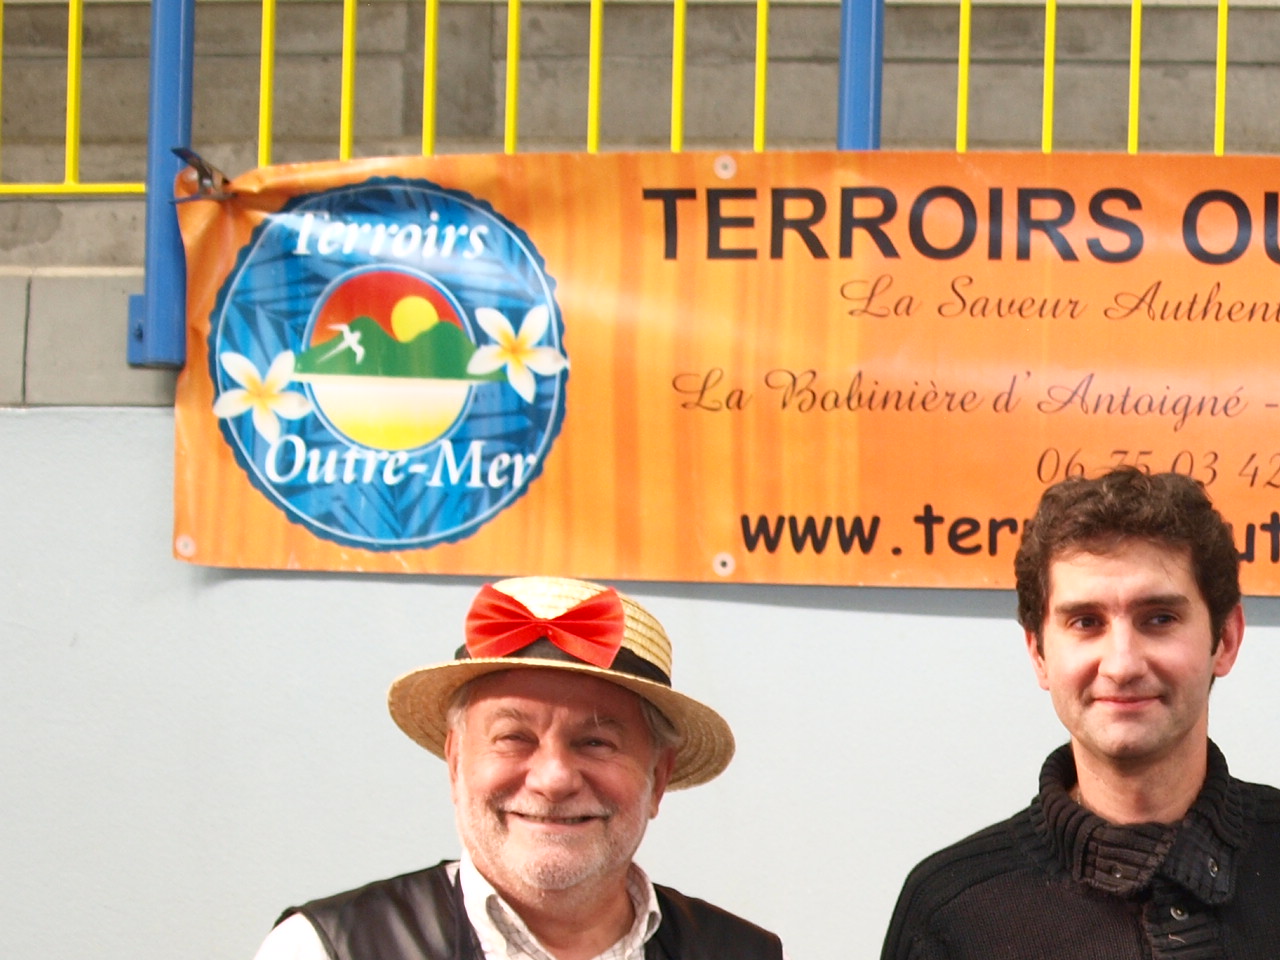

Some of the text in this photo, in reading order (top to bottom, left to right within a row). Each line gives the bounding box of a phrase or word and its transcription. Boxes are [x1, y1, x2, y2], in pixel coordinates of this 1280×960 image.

[291, 209, 489, 262] Terroirs
[642, 186, 1144, 264] TERROIRS
[840, 273, 916, 319] La
[937, 275, 1083, 324] Saveur
[672, 368, 750, 412] La
[765, 369, 984, 413] Bobinière
[263, 434, 537, 491] Outre-Mer
[1036, 447, 1086, 484] 06
[1170, 450, 1219, 486] 03
